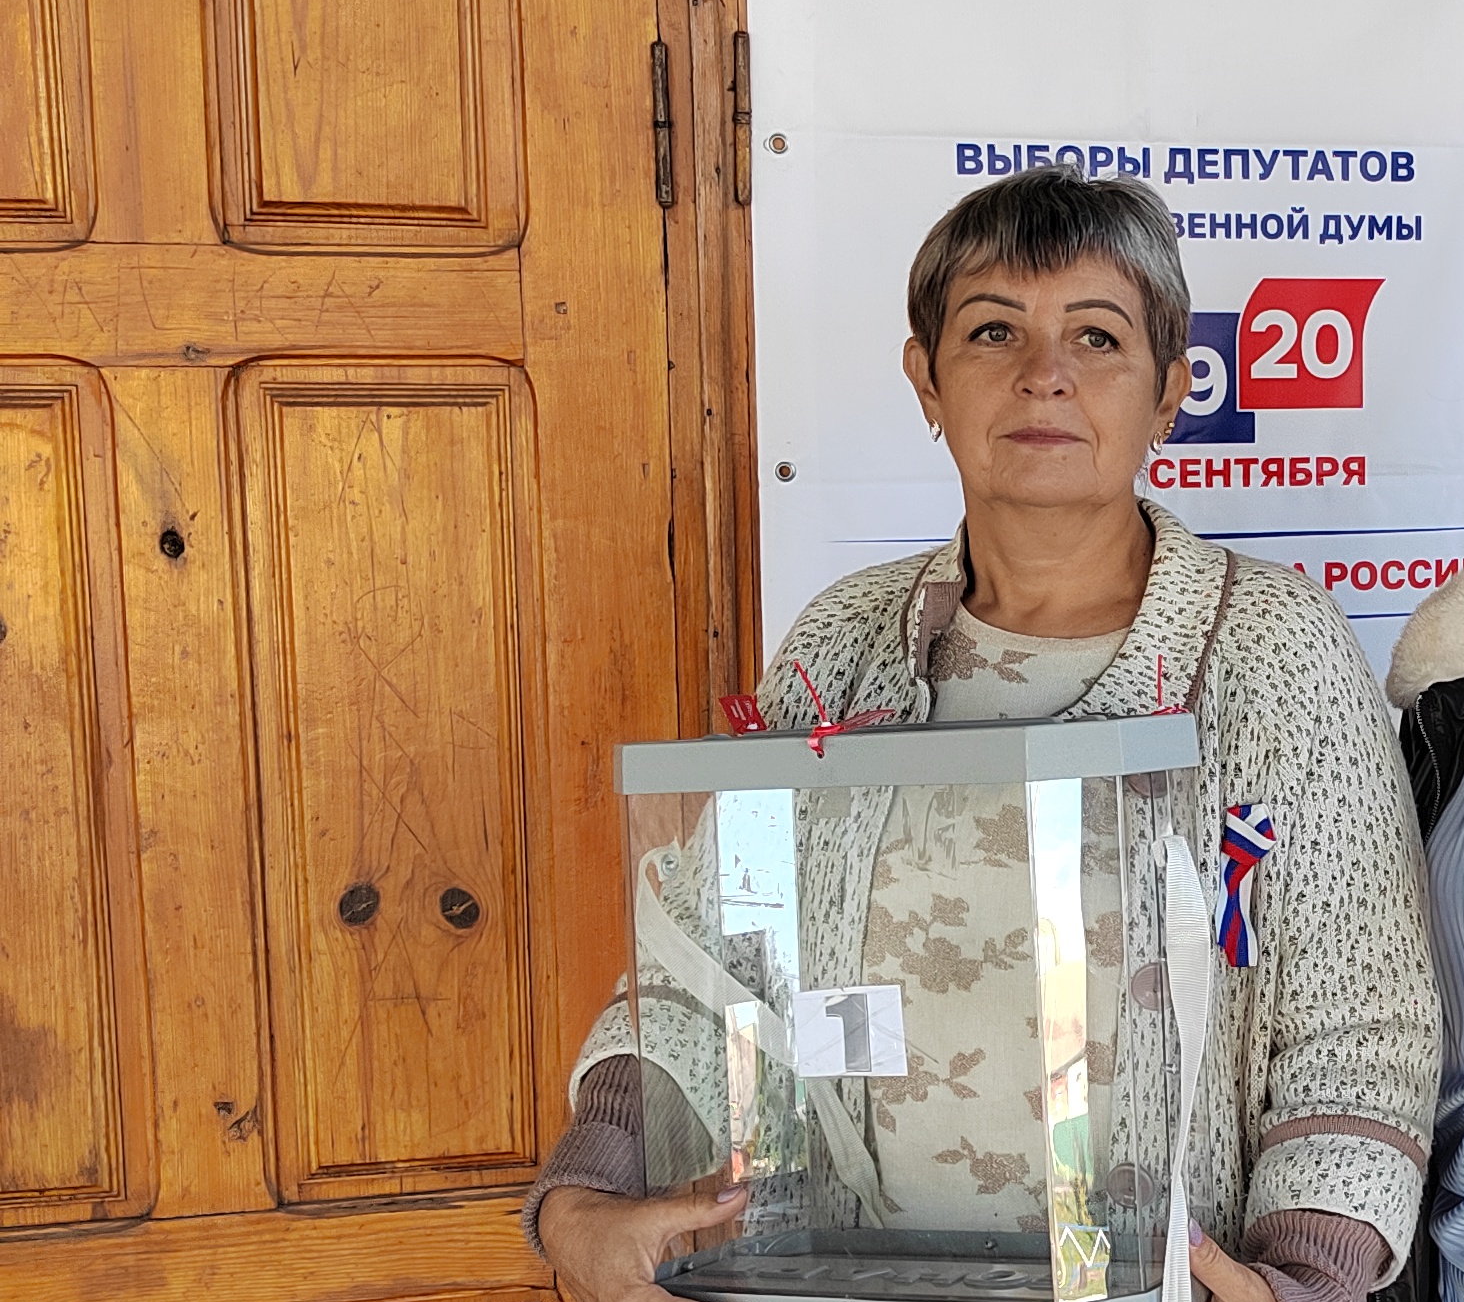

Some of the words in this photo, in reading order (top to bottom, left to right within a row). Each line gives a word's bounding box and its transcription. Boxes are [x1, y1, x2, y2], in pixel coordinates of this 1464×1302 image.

[956, 142, 1151, 180] ВЫБОРЫ
[1164, 147, 1416, 185] ДЕПУТАТОВ
[1172, 207, 1309, 241] ВЕННОЙ
[1319, 214, 1423, 245] ДУМЫ
[1180, 345, 1228, 416] 9
[1250, 309, 1353, 379] 20
[1149, 455, 1367, 490] СЕНТЯБРЯ
[825, 993, 872, 1073] 1
